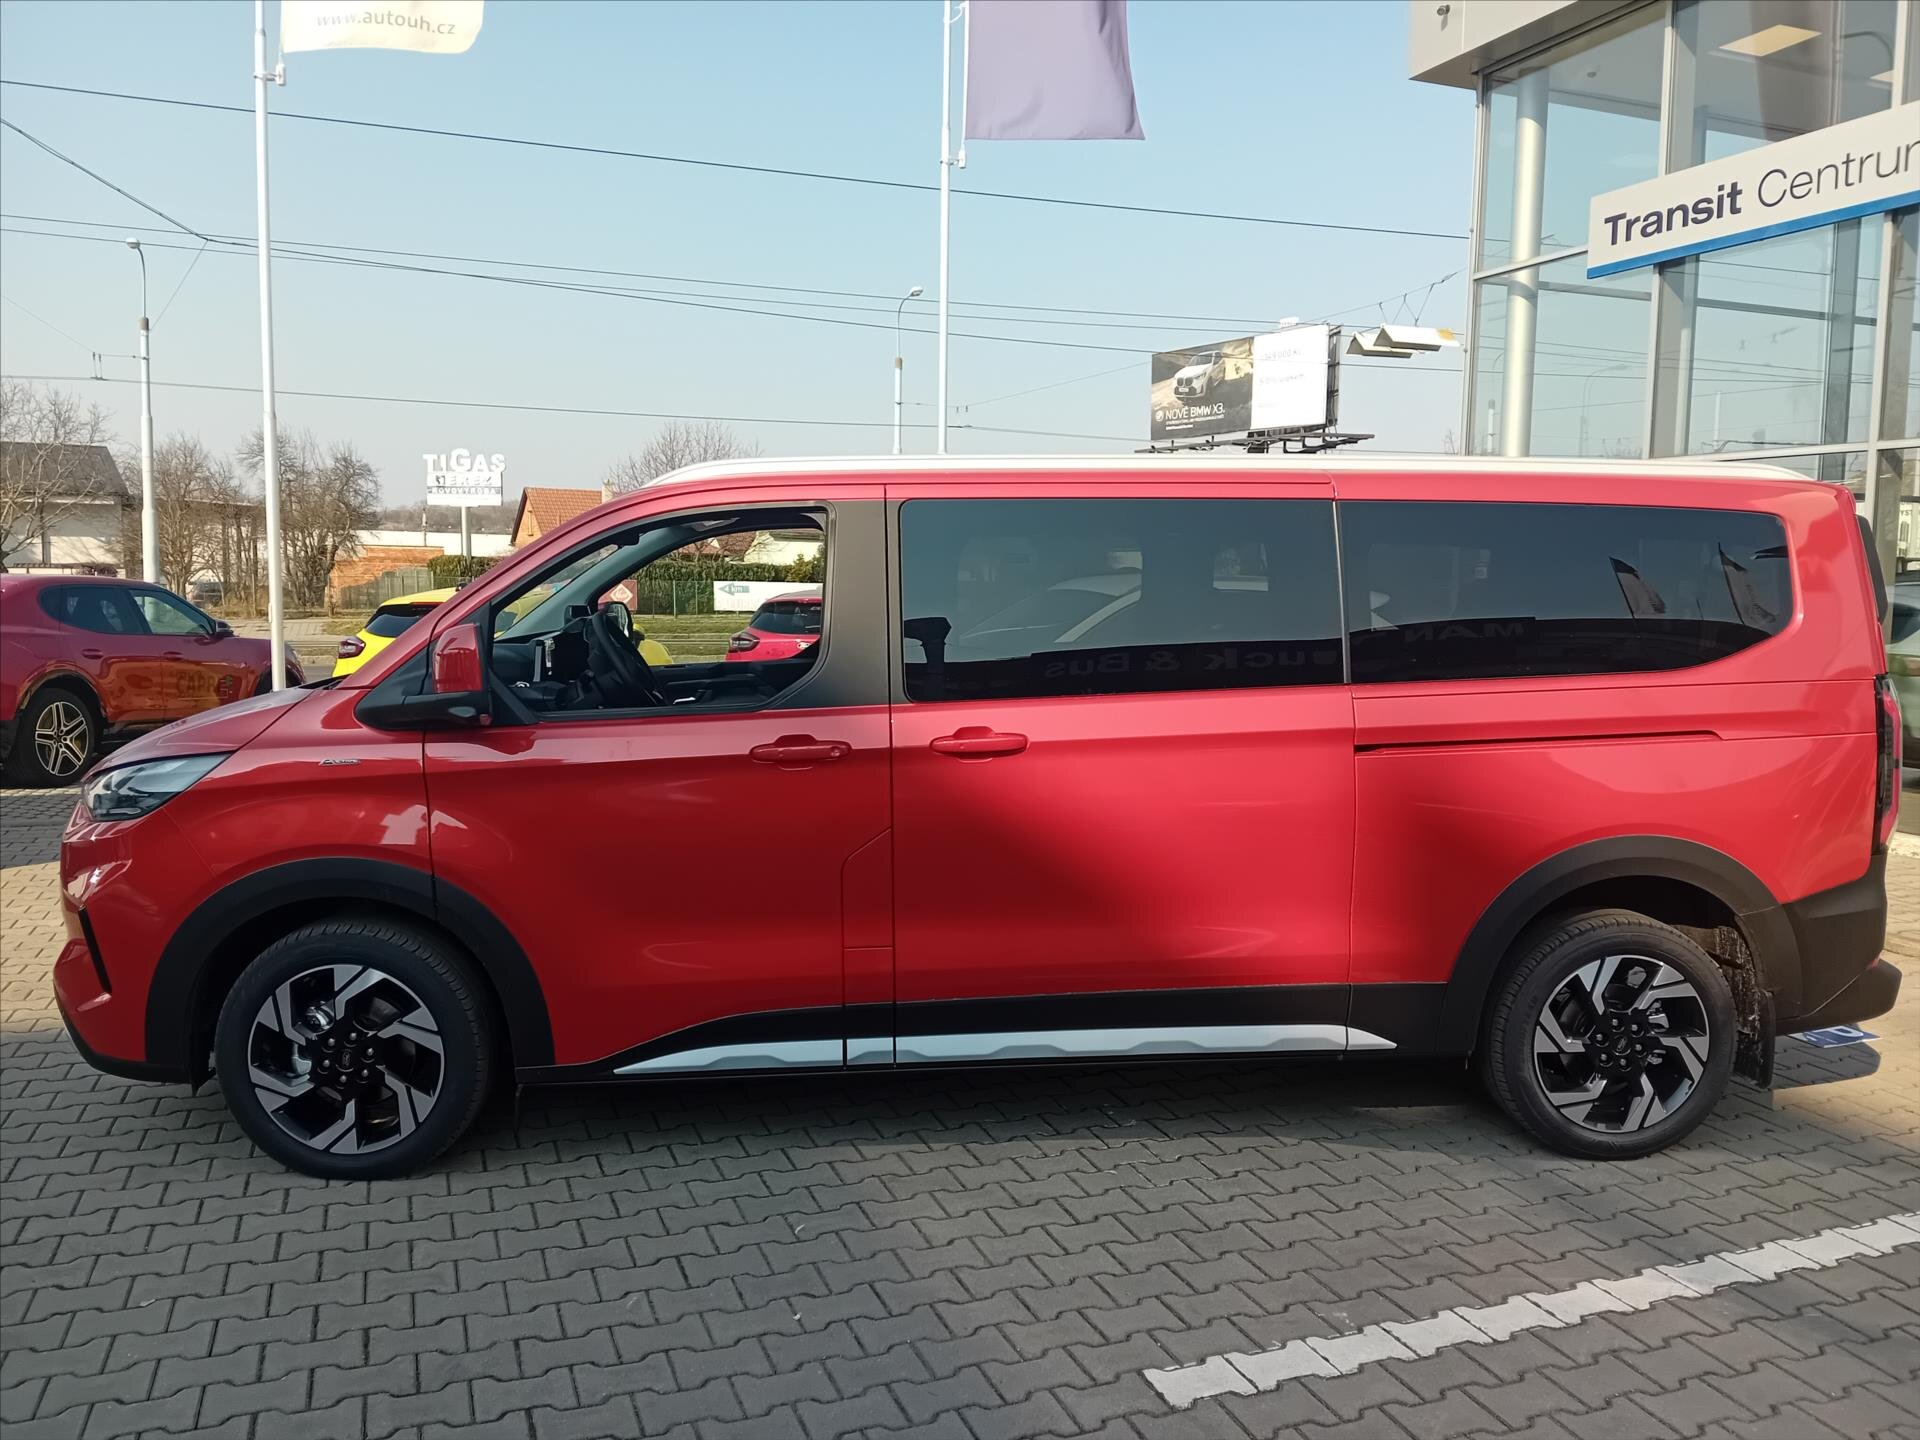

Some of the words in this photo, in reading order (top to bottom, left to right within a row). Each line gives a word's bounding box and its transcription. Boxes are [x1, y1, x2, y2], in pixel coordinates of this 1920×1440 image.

[316, 10, 456, 34] www.autouh.cz
[1604, 181, 1743, 246] Transit
[1190, 404, 1212, 417] BMW
[422, 448, 506, 473] TIGAS
